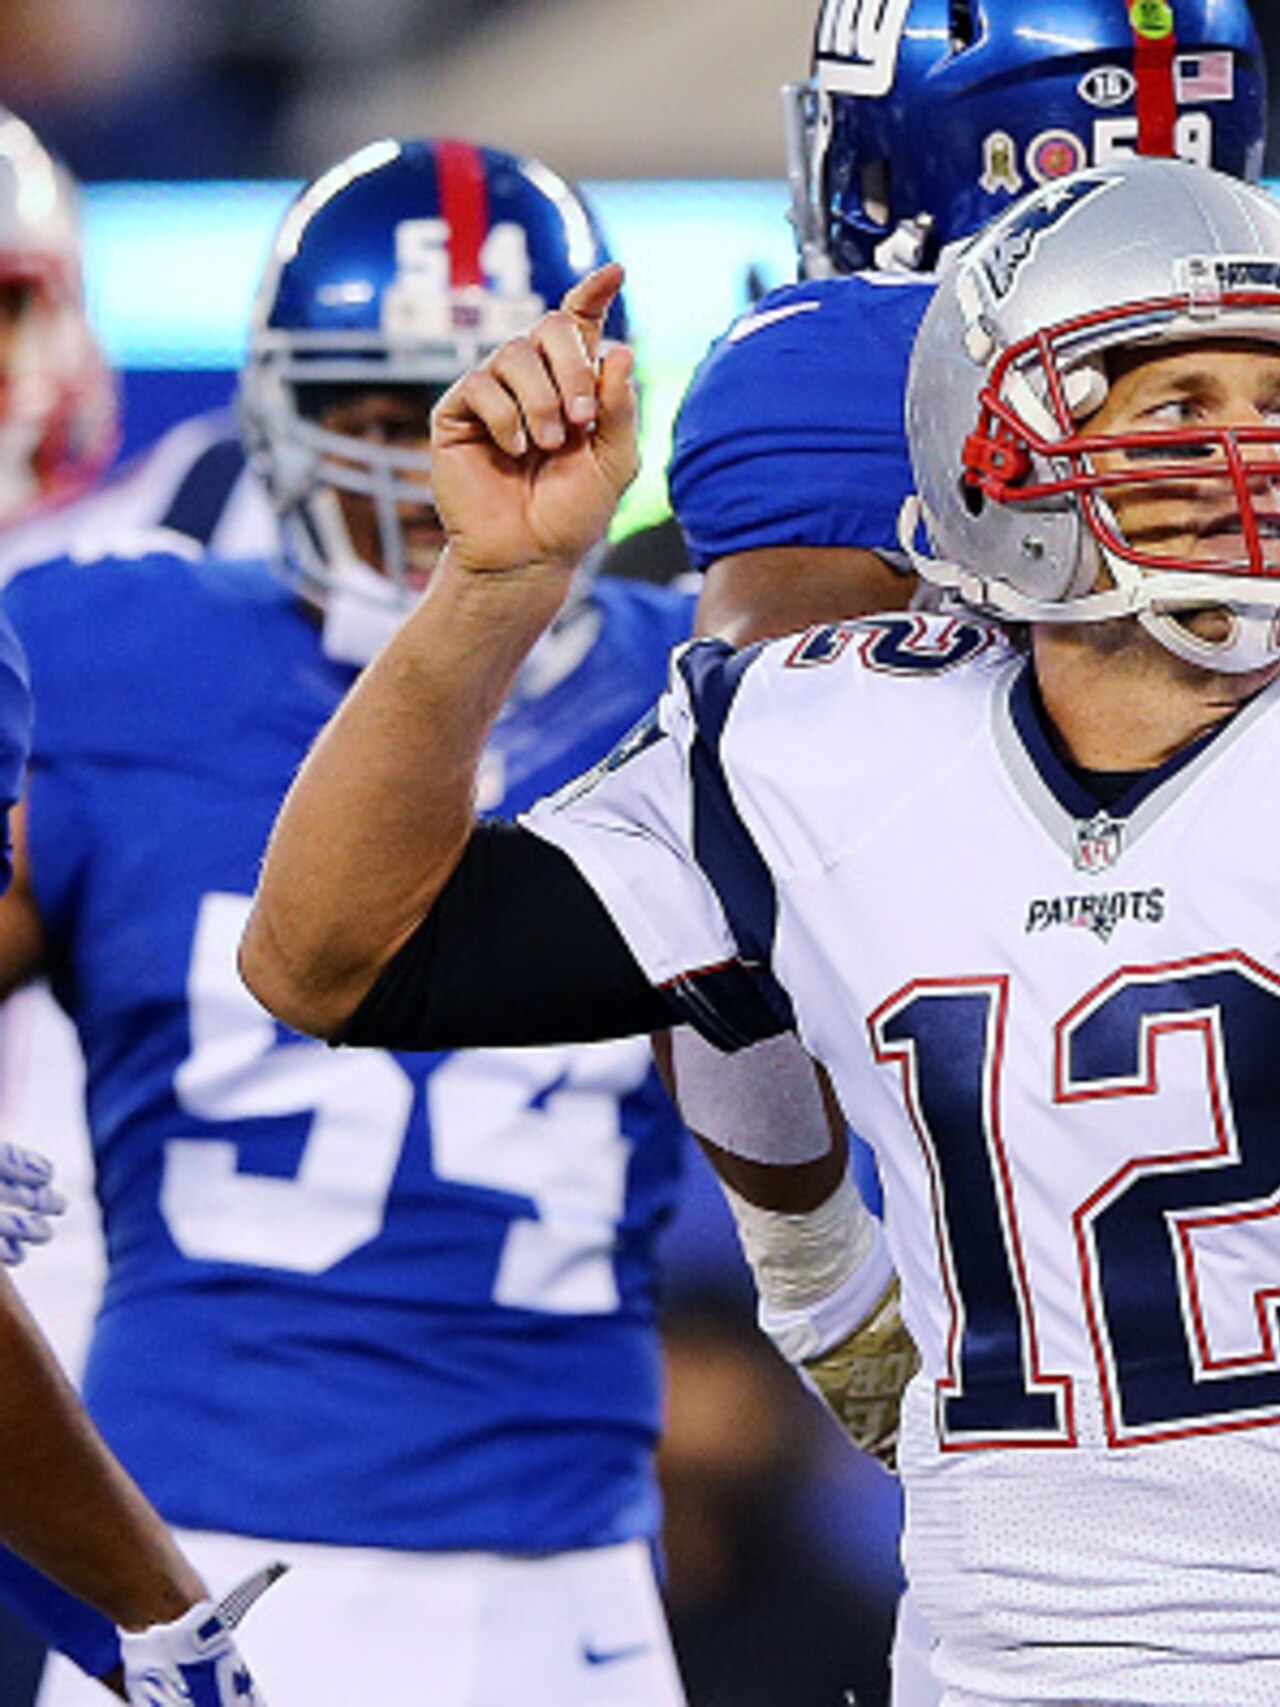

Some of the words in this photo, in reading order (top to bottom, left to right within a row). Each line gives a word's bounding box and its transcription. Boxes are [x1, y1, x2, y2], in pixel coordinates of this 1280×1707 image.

[394, 217, 533, 299] 54
[1025, 887, 1165, 935] PATRIOTS
[159, 892, 652, 1314] 54
